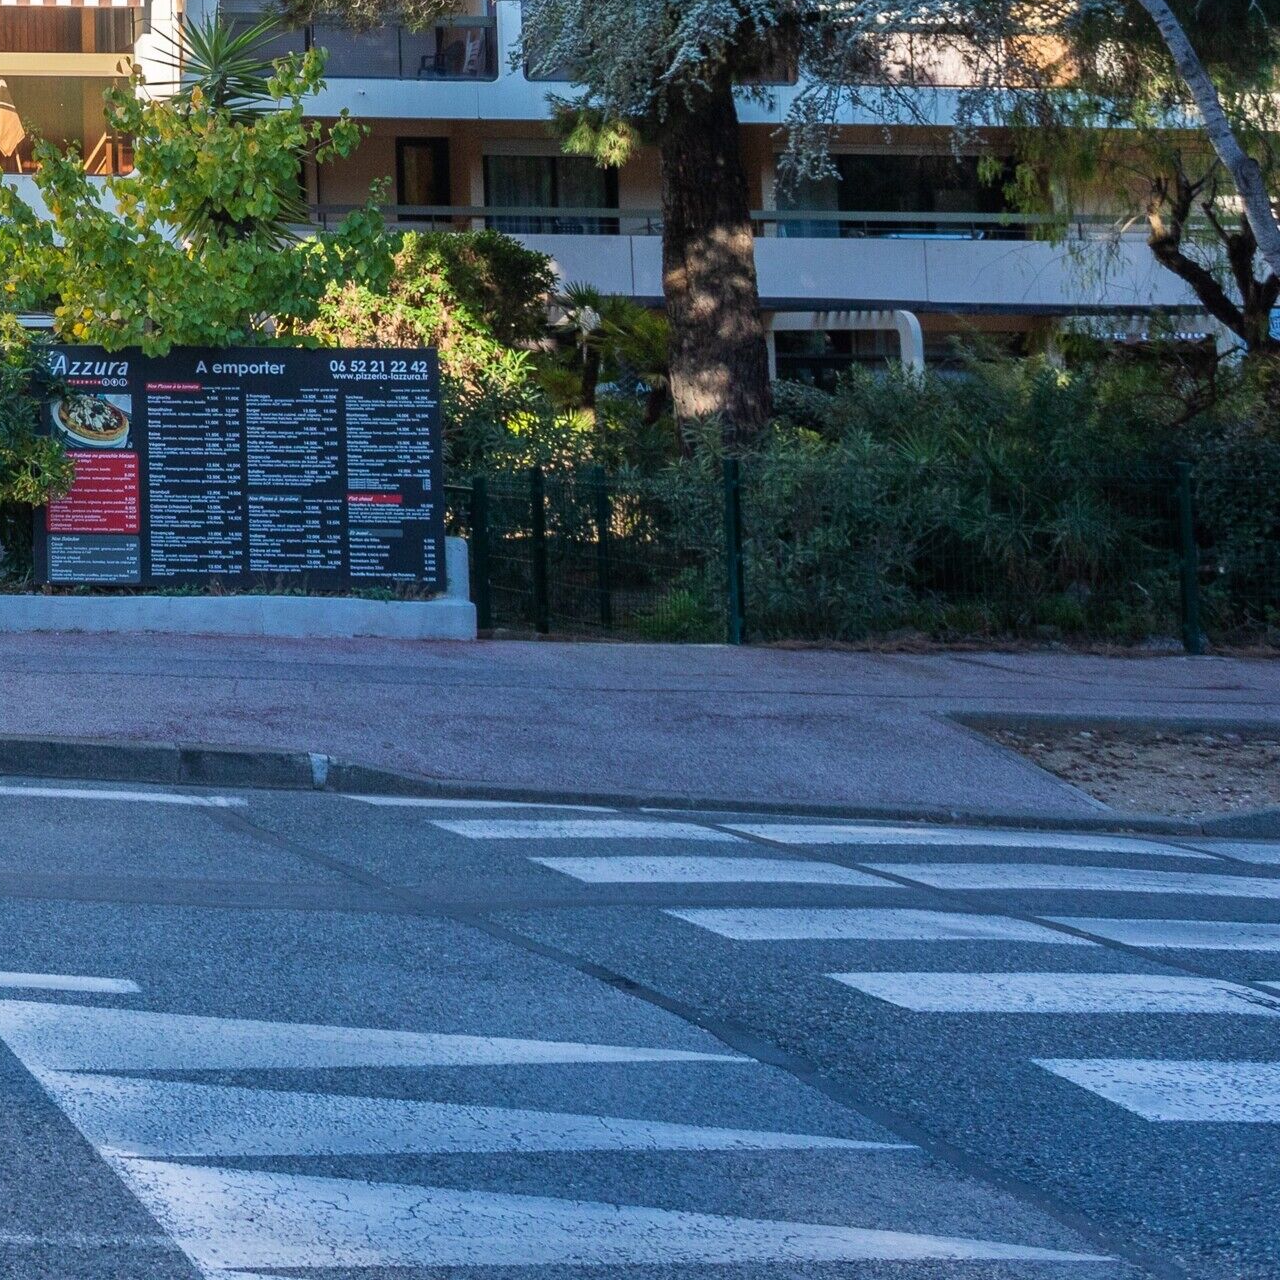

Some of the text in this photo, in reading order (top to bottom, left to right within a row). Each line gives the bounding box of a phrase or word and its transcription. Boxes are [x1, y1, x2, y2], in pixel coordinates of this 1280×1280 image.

[196, 360, 286, 377] A emporter
[330, 360, 428, 373] 06 52 21 22 42
[332, 373, 429, 381] www.pizzeria-lazzura.fr
